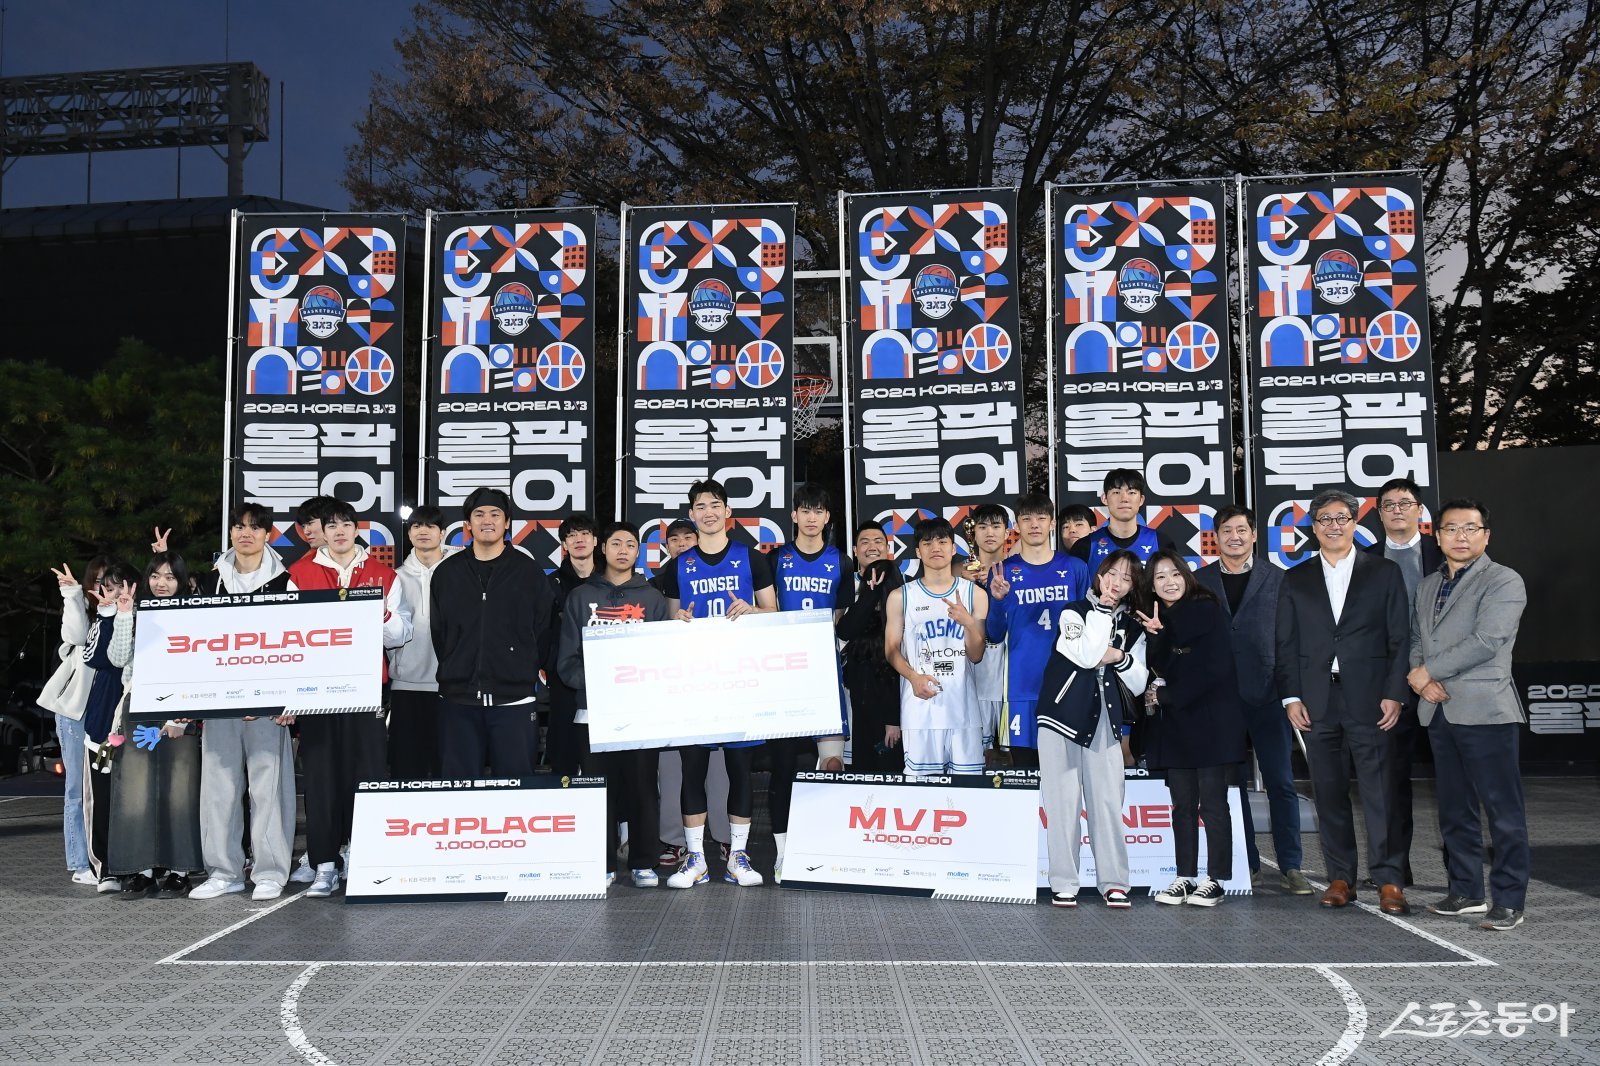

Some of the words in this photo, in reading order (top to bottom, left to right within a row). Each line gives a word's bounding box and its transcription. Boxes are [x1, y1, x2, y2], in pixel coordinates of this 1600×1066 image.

[1120, 282, 1160, 290] BASKETBALL
[1316, 273, 1358, 281] BASKETBALL
[916, 288, 955, 296] BASKETBALL
[495, 304, 532, 312] BASKETBALL
[1064, 383, 1120, 393] 2024
[1123, 382, 1194, 392] KOREA
[1260, 376, 1317, 387] 2024
[1321, 372, 1397, 385] KOREA
[861, 388, 916, 398] 2024
[919, 383, 988, 396] KOREA
[244, 404, 298, 413] 2024
[302, 404, 371, 413] KOREA
[438, 402, 490, 412] 2024
[494, 401, 561, 411] KOREA
[634, 399, 688, 409] 2024
[692, 398, 760, 408] KOREA
[862, 402, 1017, 452] 올팍
[1065, 401, 1225, 449] 올팍
[1261, 392, 1428, 443] 올팍
[243, 423, 396, 464] 올팍
[437, 421, 587, 463] 올팍
[635, 415, 787, 462] 올팍
[863, 450, 1020, 499] 투어
[1262, 443, 1430, 490] 투어
[242, 471, 394, 512] 투어
[634, 466, 786, 510] 투어
[690, 576, 740, 595] YONSEI
[783, 577, 833, 594] YONSEI
[1014, 585, 1069, 605] YONSEI
[139, 598, 180, 608] 2024
[181, 596, 232, 606] KOREA
[706, 598, 725, 617] 10
[1037, 609, 1052, 630] 4
[167, 634, 229, 654] 3rd
[234, 627, 353, 651] PLACE
[215, 653, 304, 667] 1,000,000
[613, 663, 683, 684] 2nd
[689, 651, 809, 680] PLACE
[1009, 714, 1021, 736] 4
[358, 781, 400, 790] 2024
[401, 780, 453, 789] KOREA
[795, 771, 834, 781] 2024
[835, 773, 884, 782] KOREA
[385, 818, 449, 837] 3rd
[454, 815, 576, 835] PLACE
[848, 806, 968, 833] MVP
[434, 839, 527, 851] 1,000,000
[862, 833, 953, 846] 1,000,000
